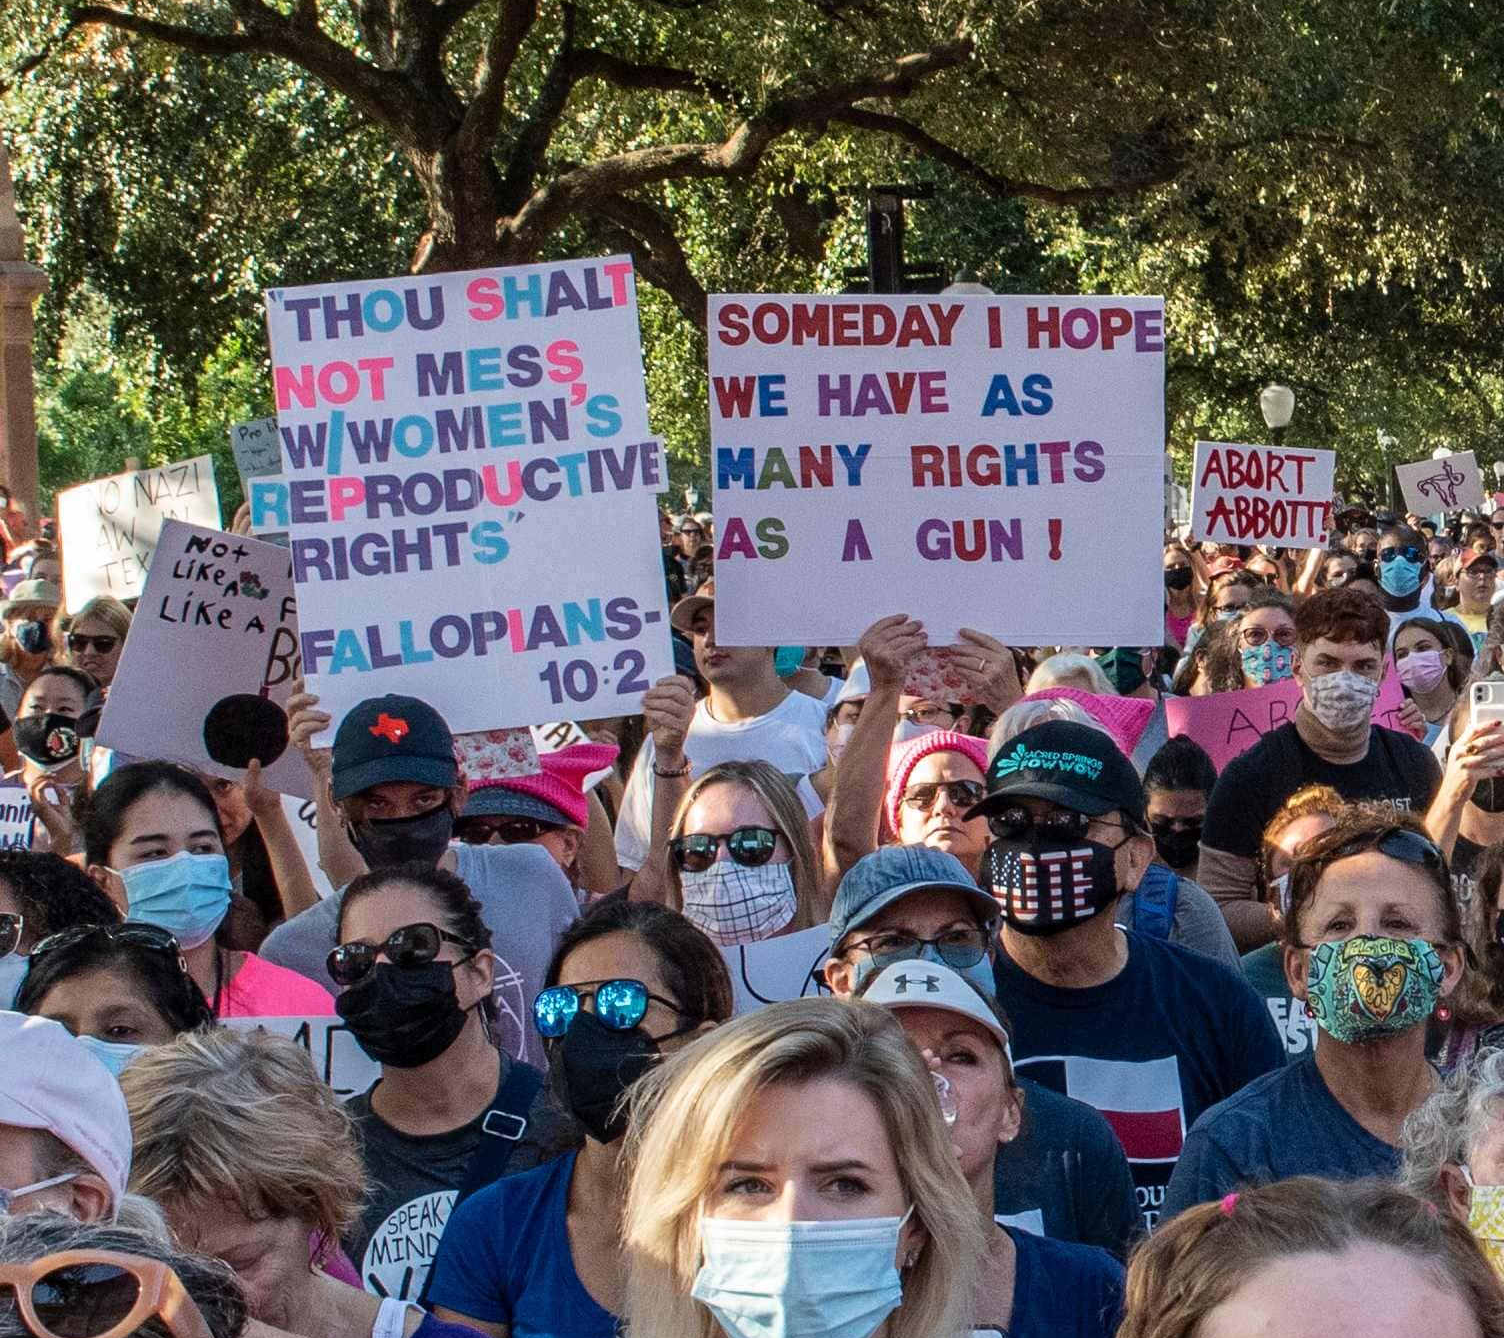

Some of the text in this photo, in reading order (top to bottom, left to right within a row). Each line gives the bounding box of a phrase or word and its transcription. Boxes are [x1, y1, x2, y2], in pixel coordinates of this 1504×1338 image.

[467, 261, 632, 322] SHALT
[717, 303, 1164, 353] SOMEDAY I HOPE
[276, 339, 584, 411] NOT MESS
[712, 371, 1054, 418] WE HAVE AS
[132, 462, 202, 509] NAZI
[252, 442, 661, 530] REPRODUCTIVE
[717, 440, 1106, 491] MANY RIGHTS
[1200, 449, 1316, 495] ABORT
[99, 516, 137, 550] AW
[717, 516, 791, 561] AS
[841, 518, 873, 562] A
[915, 517, 1025, 563] GUN
[1204, 499, 1331, 545] ABBOTT!
[539, 658, 650, 706] 10:2
[386, 1201, 445, 1236] SPEAK
